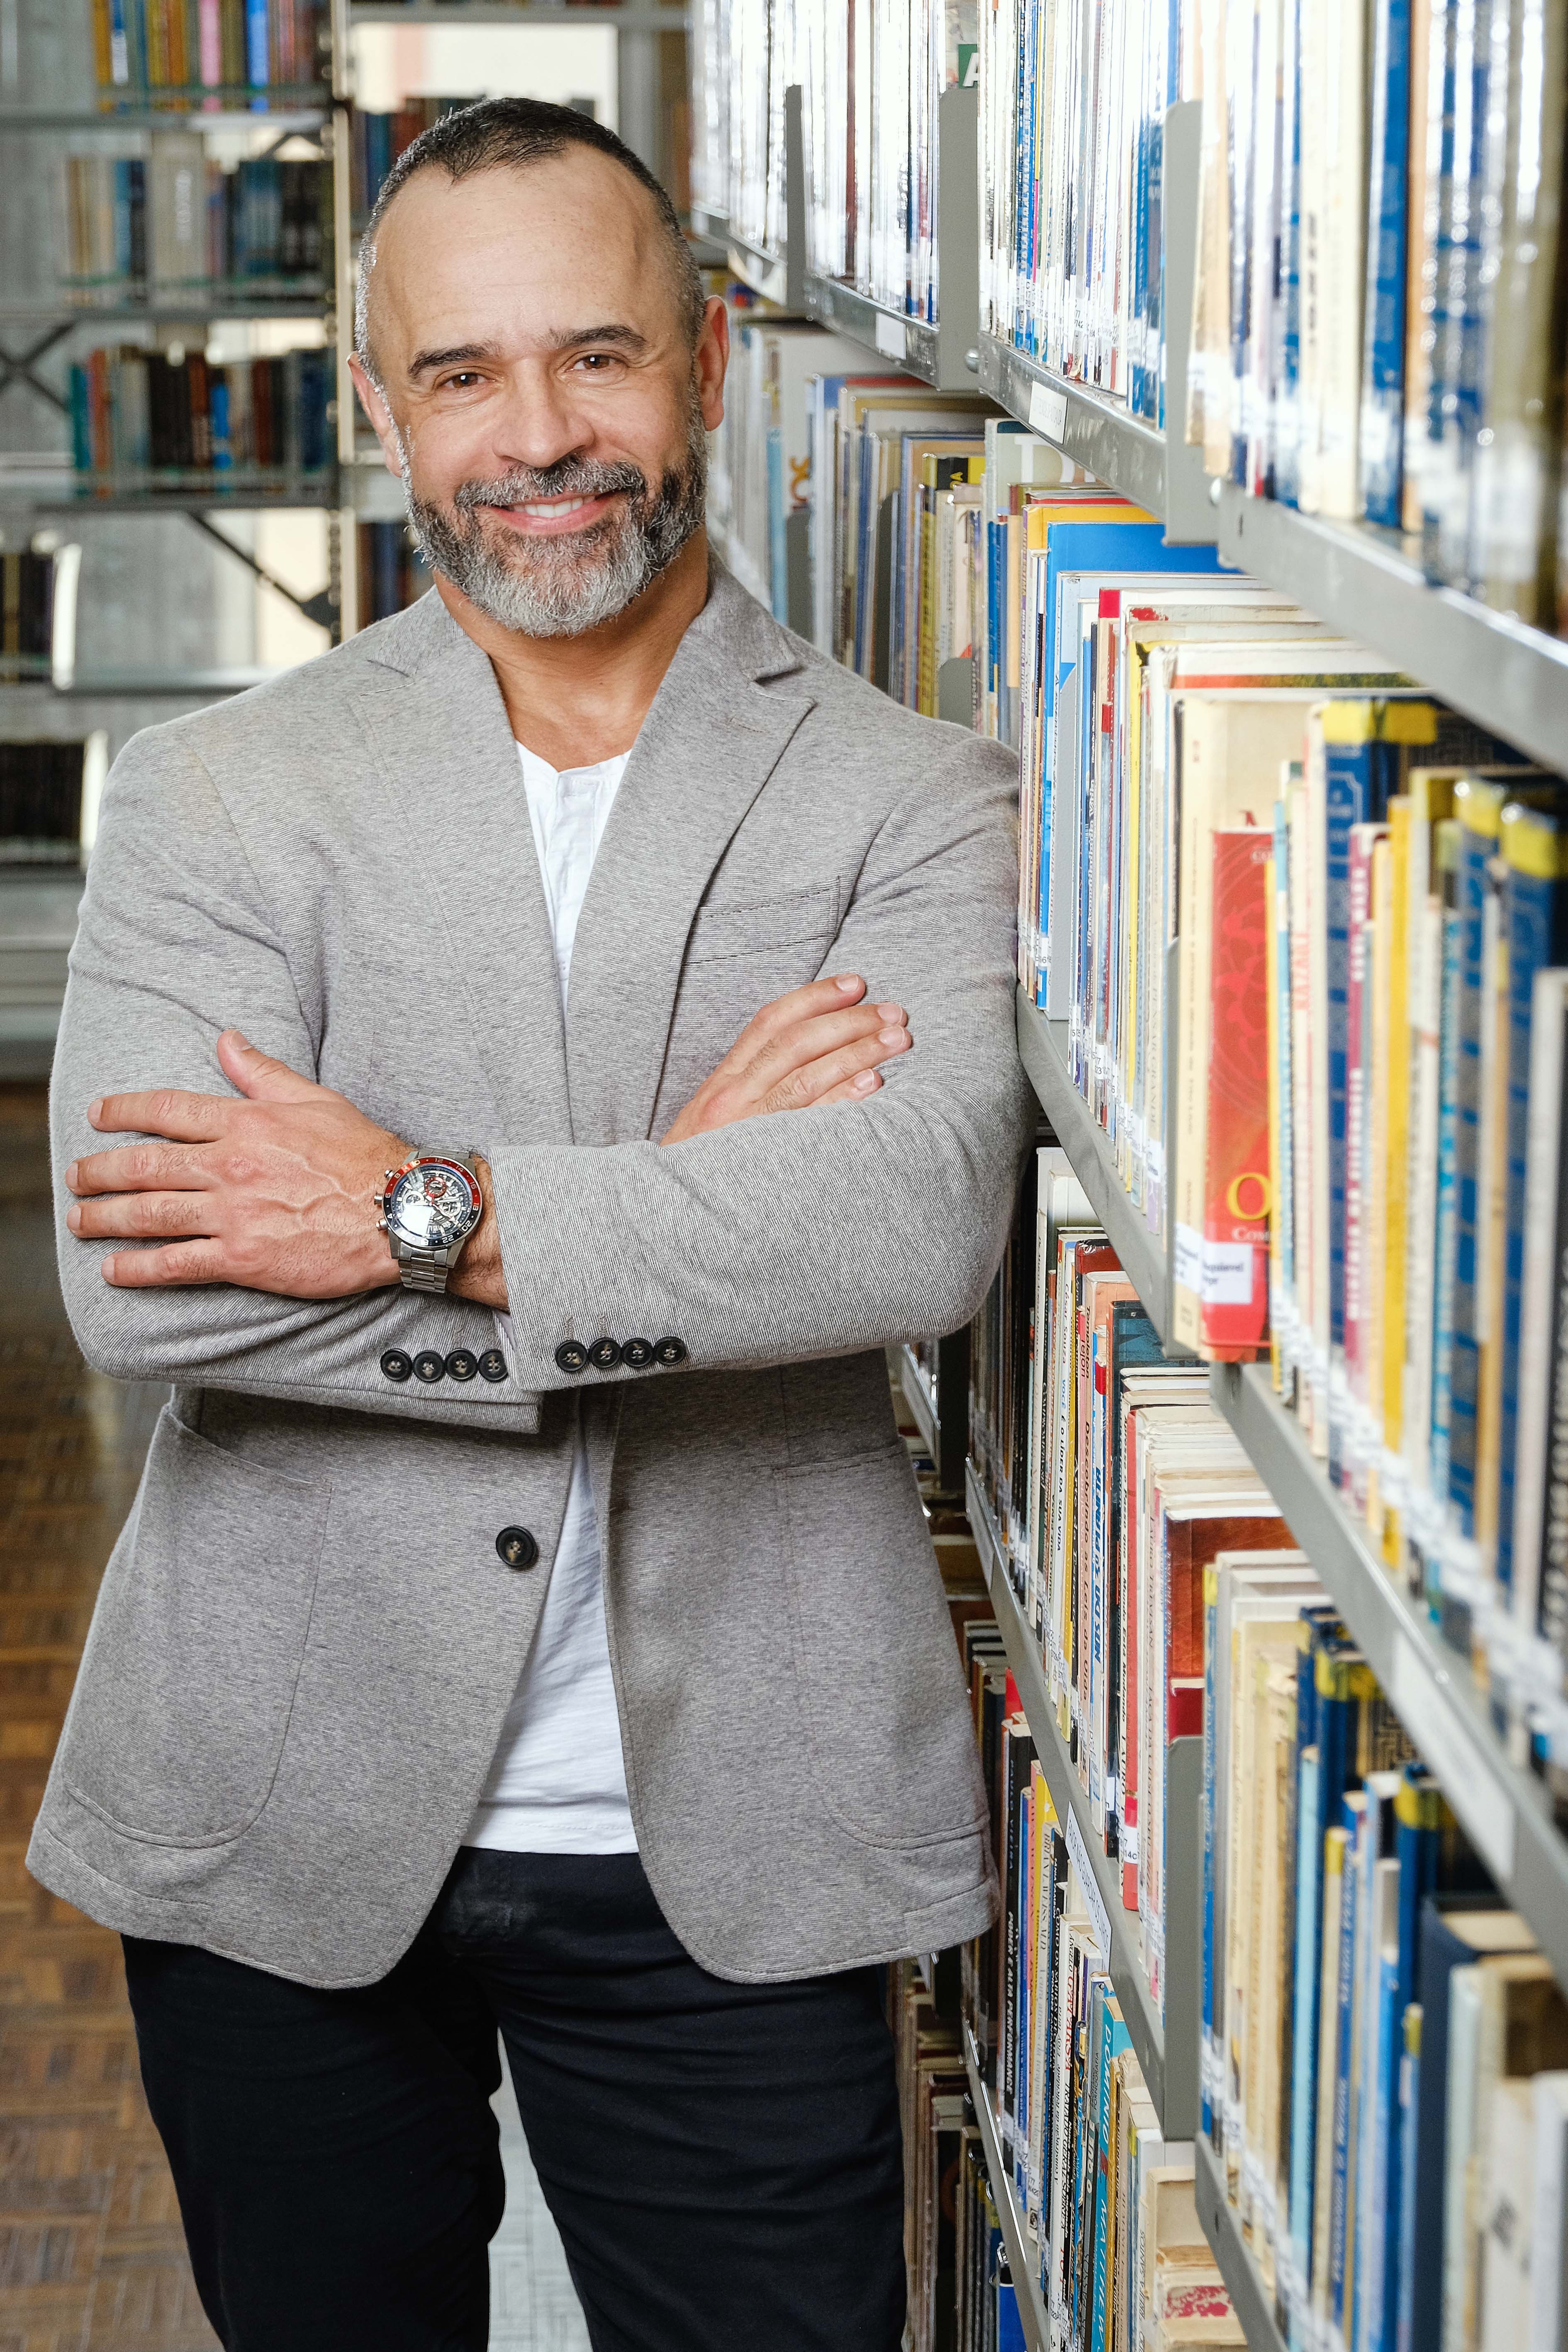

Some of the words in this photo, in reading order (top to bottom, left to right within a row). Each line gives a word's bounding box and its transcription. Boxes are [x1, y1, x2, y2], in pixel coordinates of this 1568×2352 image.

[472, 1203, 480, 1211] 18
[461, 1220, 472, 1232] 20
[442, 1235, 454, 1243] 22
[1059, 1477, 1063, 1494] DA
[1074, 1515, 1078, 1541] da
[1084, 1551, 1088, 1572] as
[1083, 1628, 1088, 1651] da
[1068, 1819, 1077, 1857] FAVOR
[1081, 1861, 1096, 1912] GUARDAR
[1095, 1899, 1100, 1924] OS
[1099, 1915, 1109, 1954] LIVROS
[1086, 2178, 1093, 2195] O
[1098, 2198, 1107, 2343] MATTHEW
